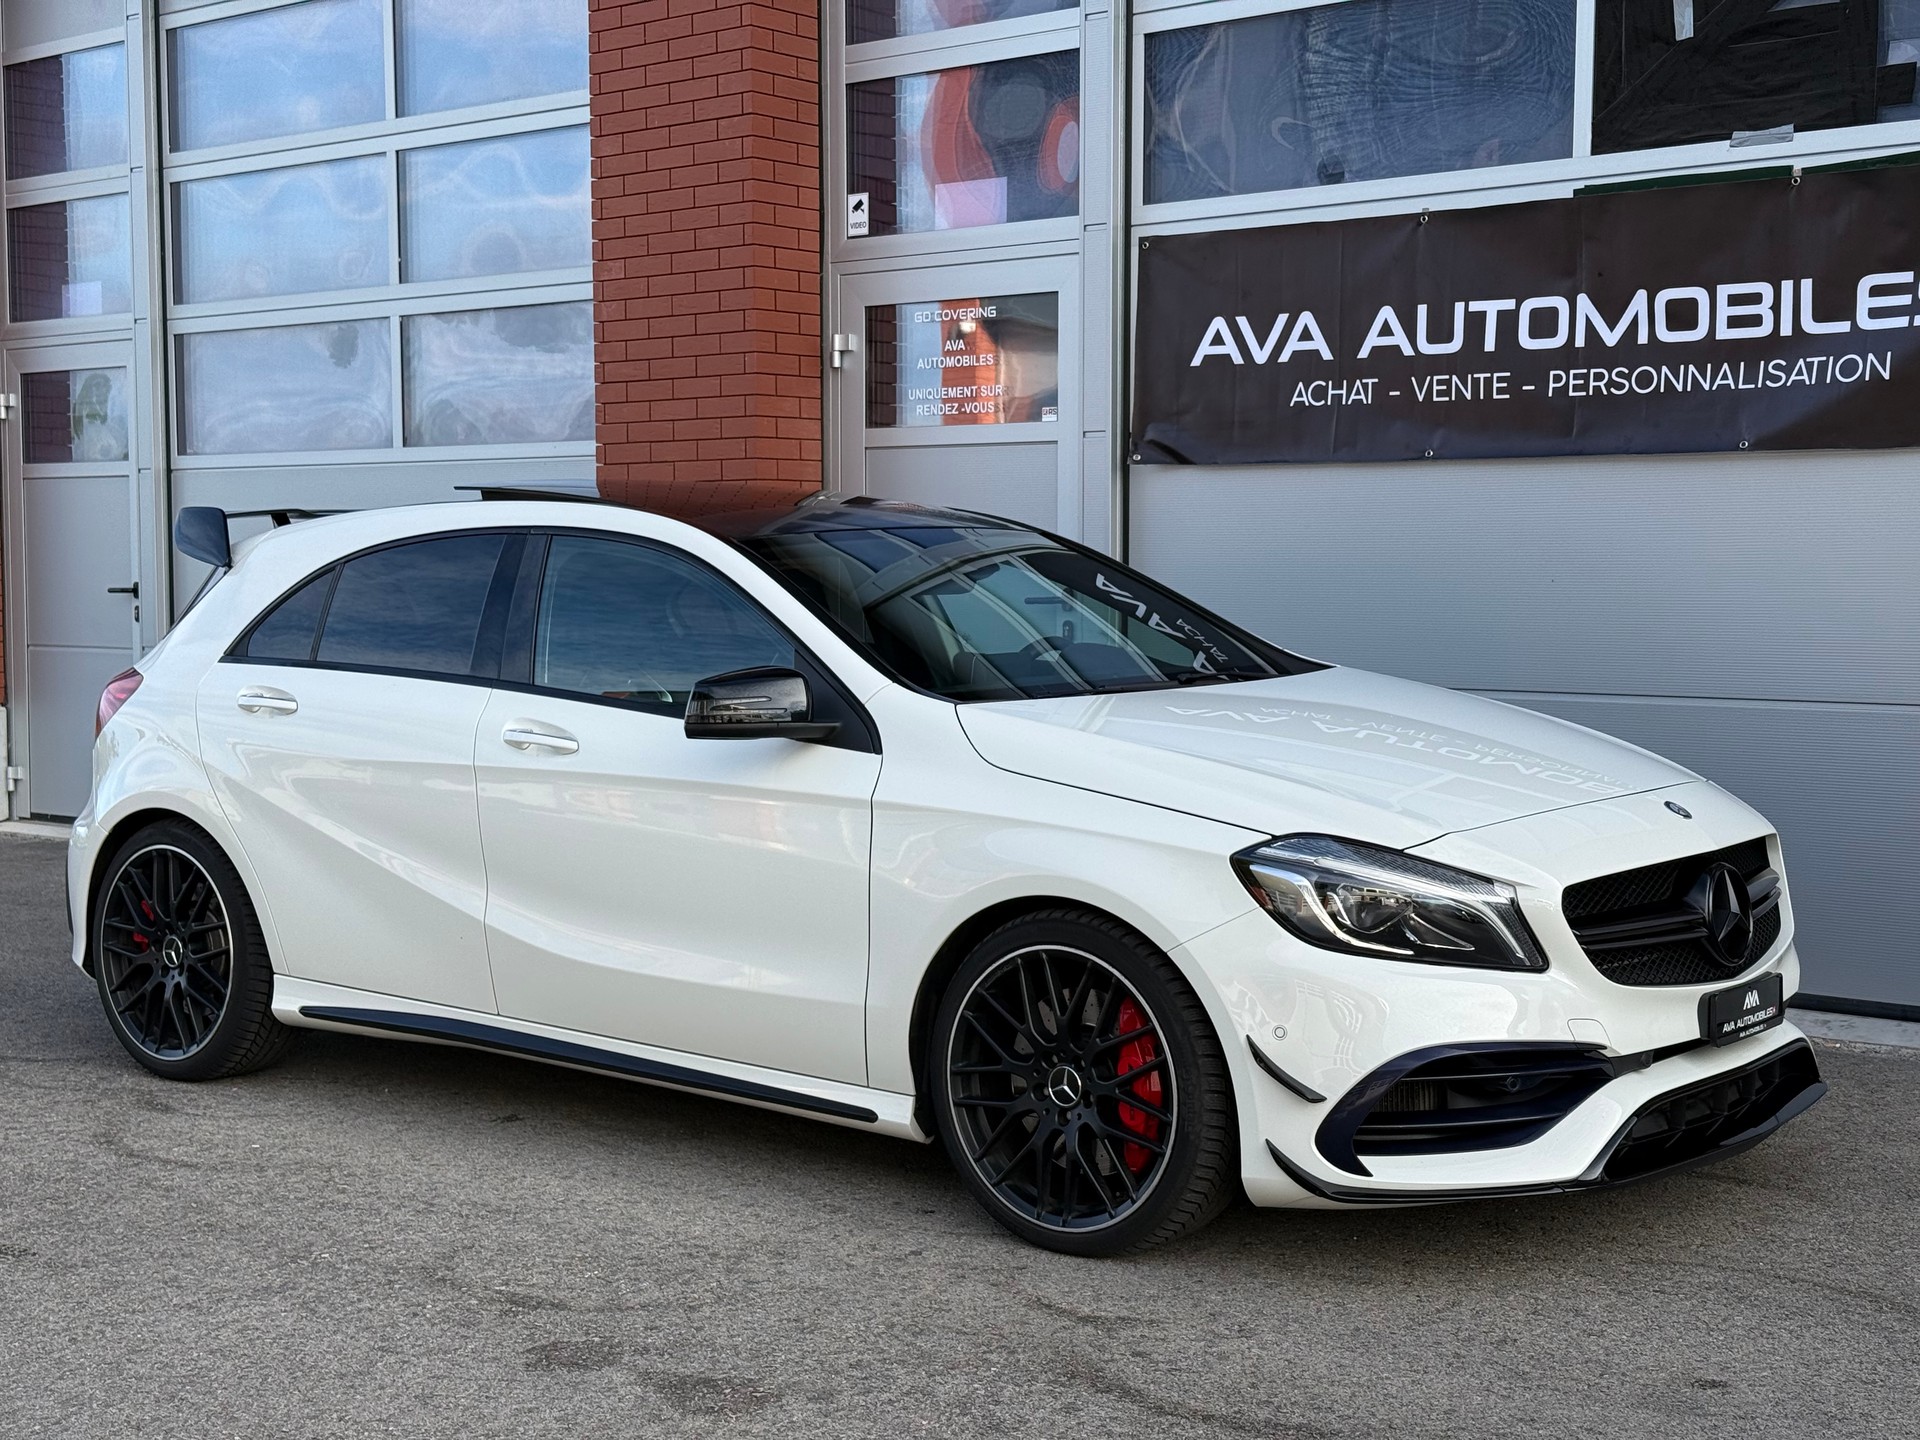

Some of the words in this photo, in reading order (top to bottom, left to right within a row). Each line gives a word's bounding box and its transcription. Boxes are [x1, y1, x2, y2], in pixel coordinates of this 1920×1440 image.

[850, 221, 867, 229] VIDEO
[934, 306, 997, 321] COVERING
[1190, 311, 1334, 366] AVA
[1357, 271, 1920, 358] AUTOMOBILE
[944, 340, 966, 352] AVA
[917, 354, 994, 369] AUTOMOBILES
[1290, 379, 1378, 406] ACHAT
[1412, 373, 1511, 401] VENTE
[1549, 352, 1892, 397] PERSONNALISATION
[908, 386, 978, 400] UNIQUEMENT
[980, 385, 1003, 397] SUR
[916, 403, 959, 416] RENDEZ
[1722, 1021, 1736, 1033] AVA
[1736, 1007, 1774, 1028] AUTOMOBILES
